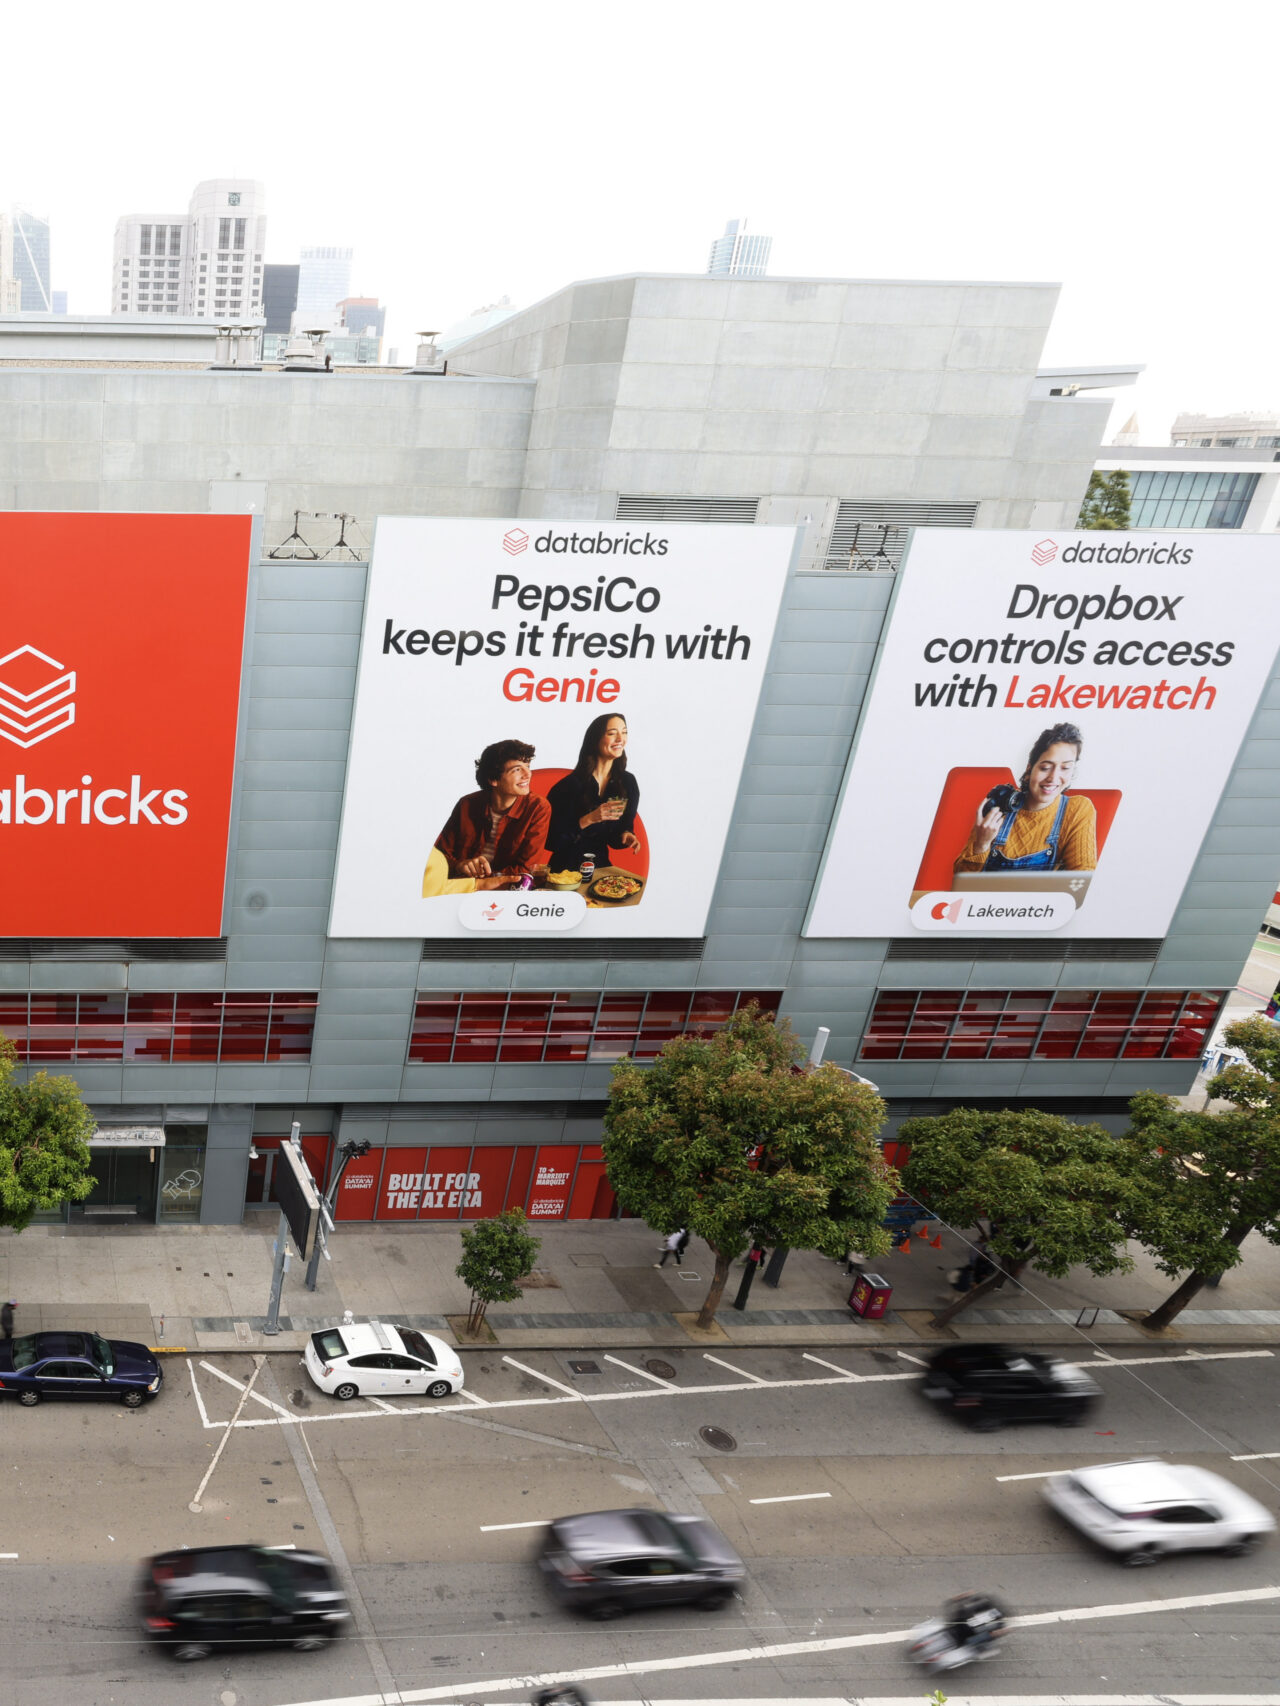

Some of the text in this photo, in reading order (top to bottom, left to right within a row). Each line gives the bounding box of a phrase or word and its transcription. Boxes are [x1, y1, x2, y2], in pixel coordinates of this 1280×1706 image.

[534, 530, 669, 556] databricks
[1062, 540, 1194, 565] databricks
[491, 574, 661, 622] PepsiCo
[1006, 584, 1184, 630] Dropbox
[382, 618, 751, 666] keeps it fresh with
[923, 630, 1235, 667] controls access
[502, 667, 621, 704] Genie
[914, 673, 1217, 710] with Lakewatch
[516, 903, 565, 917] Genie
[967, 904, 1054, 918] Lakewatch
[388, 1172, 481, 1191] BUILT FOR
[536, 1179, 566, 1187] MARQUIS
[386, 1190, 483, 1209] THE AI ERA
